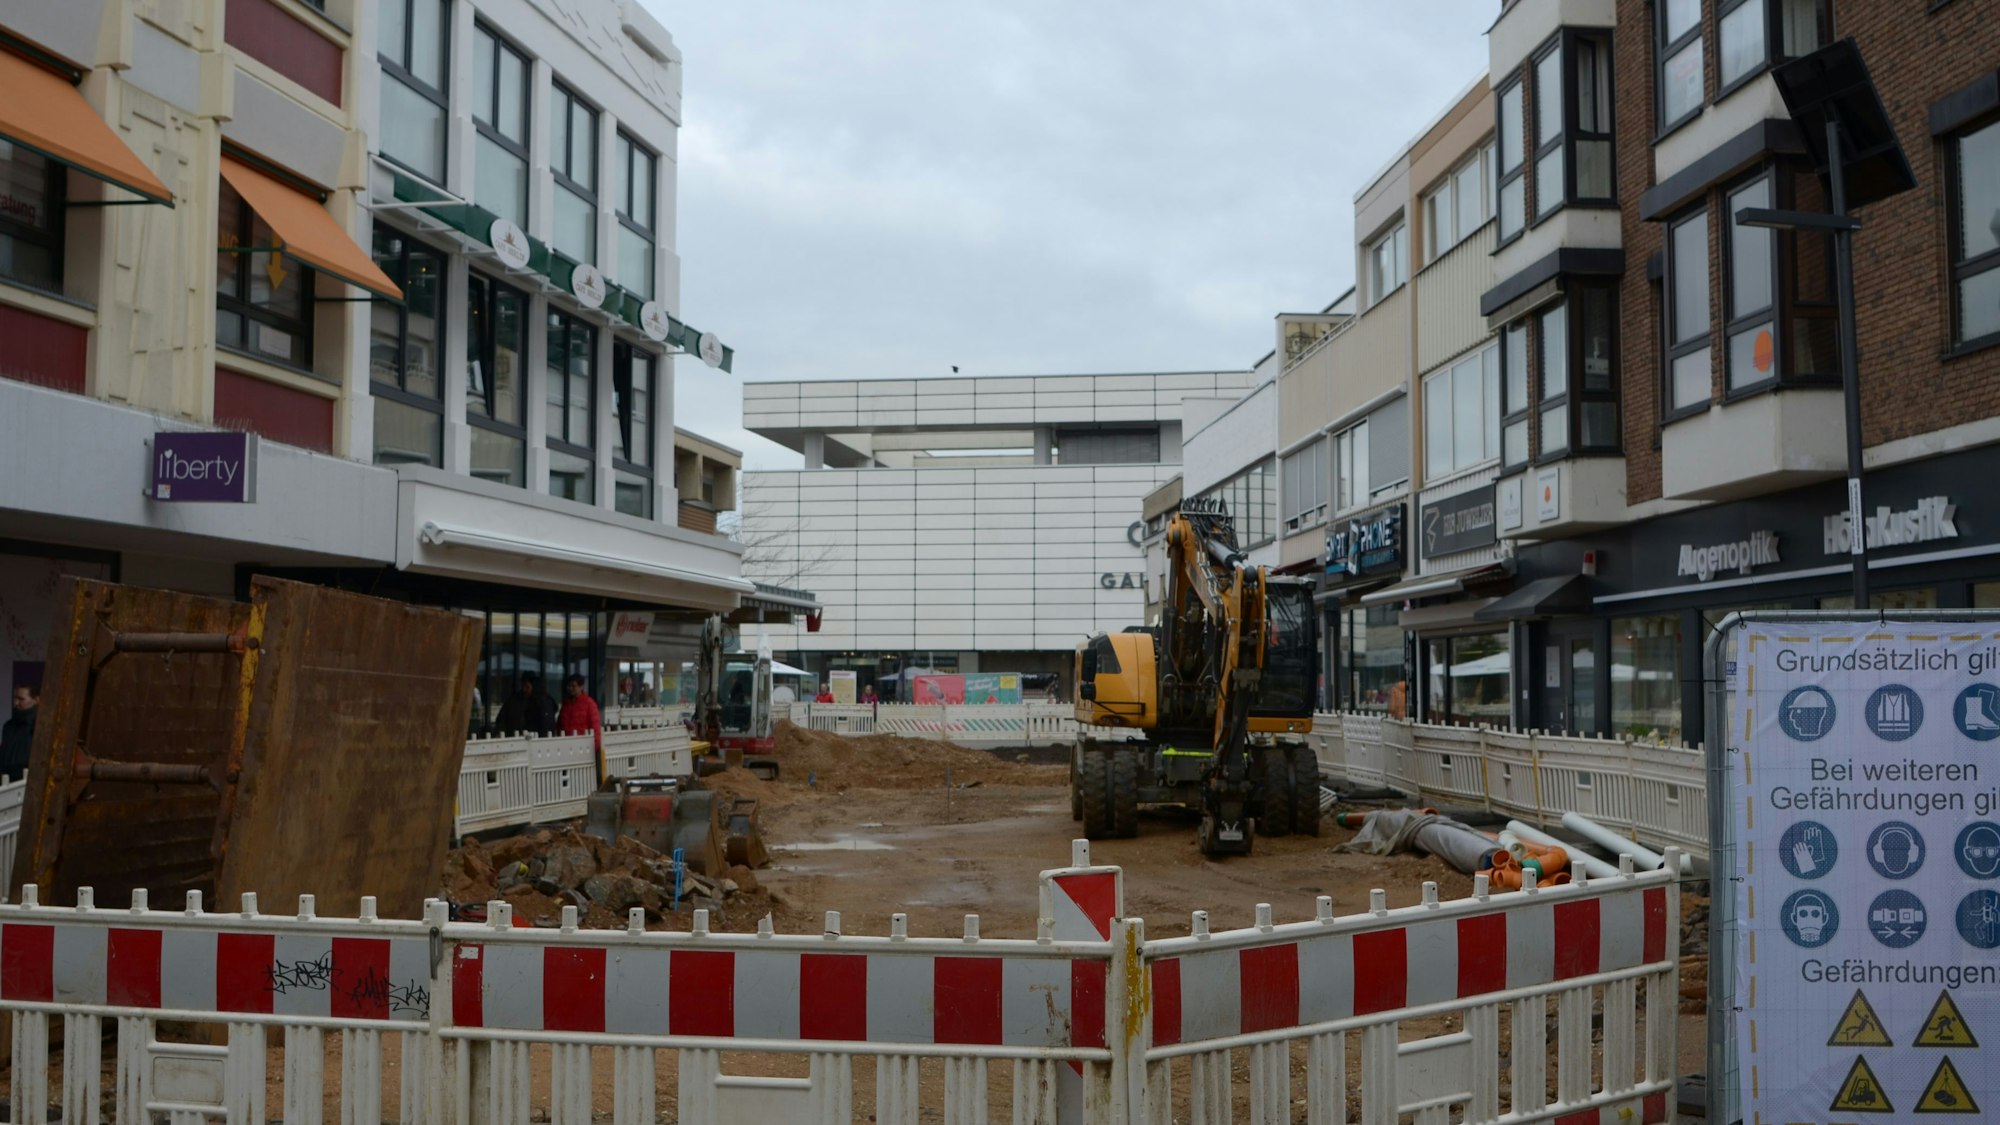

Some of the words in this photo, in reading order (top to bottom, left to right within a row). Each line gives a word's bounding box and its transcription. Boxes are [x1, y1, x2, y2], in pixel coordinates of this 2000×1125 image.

[0, 191, 36, 223] atung
[159, 449, 239, 487] liberty
[1361, 517, 1392, 553] PHONE
[1823, 496, 1958, 555] Höakustik
[1678, 530, 1782, 581] Augenoptik
[1776, 648, 1958, 673] Grundsätzlich
[1968, 646, 2000, 676] gil
[1811, 758, 1853, 781] Bei
[1862, 758, 1978, 781] weiteren
[1770, 786, 1964, 816] Gefährdungen
